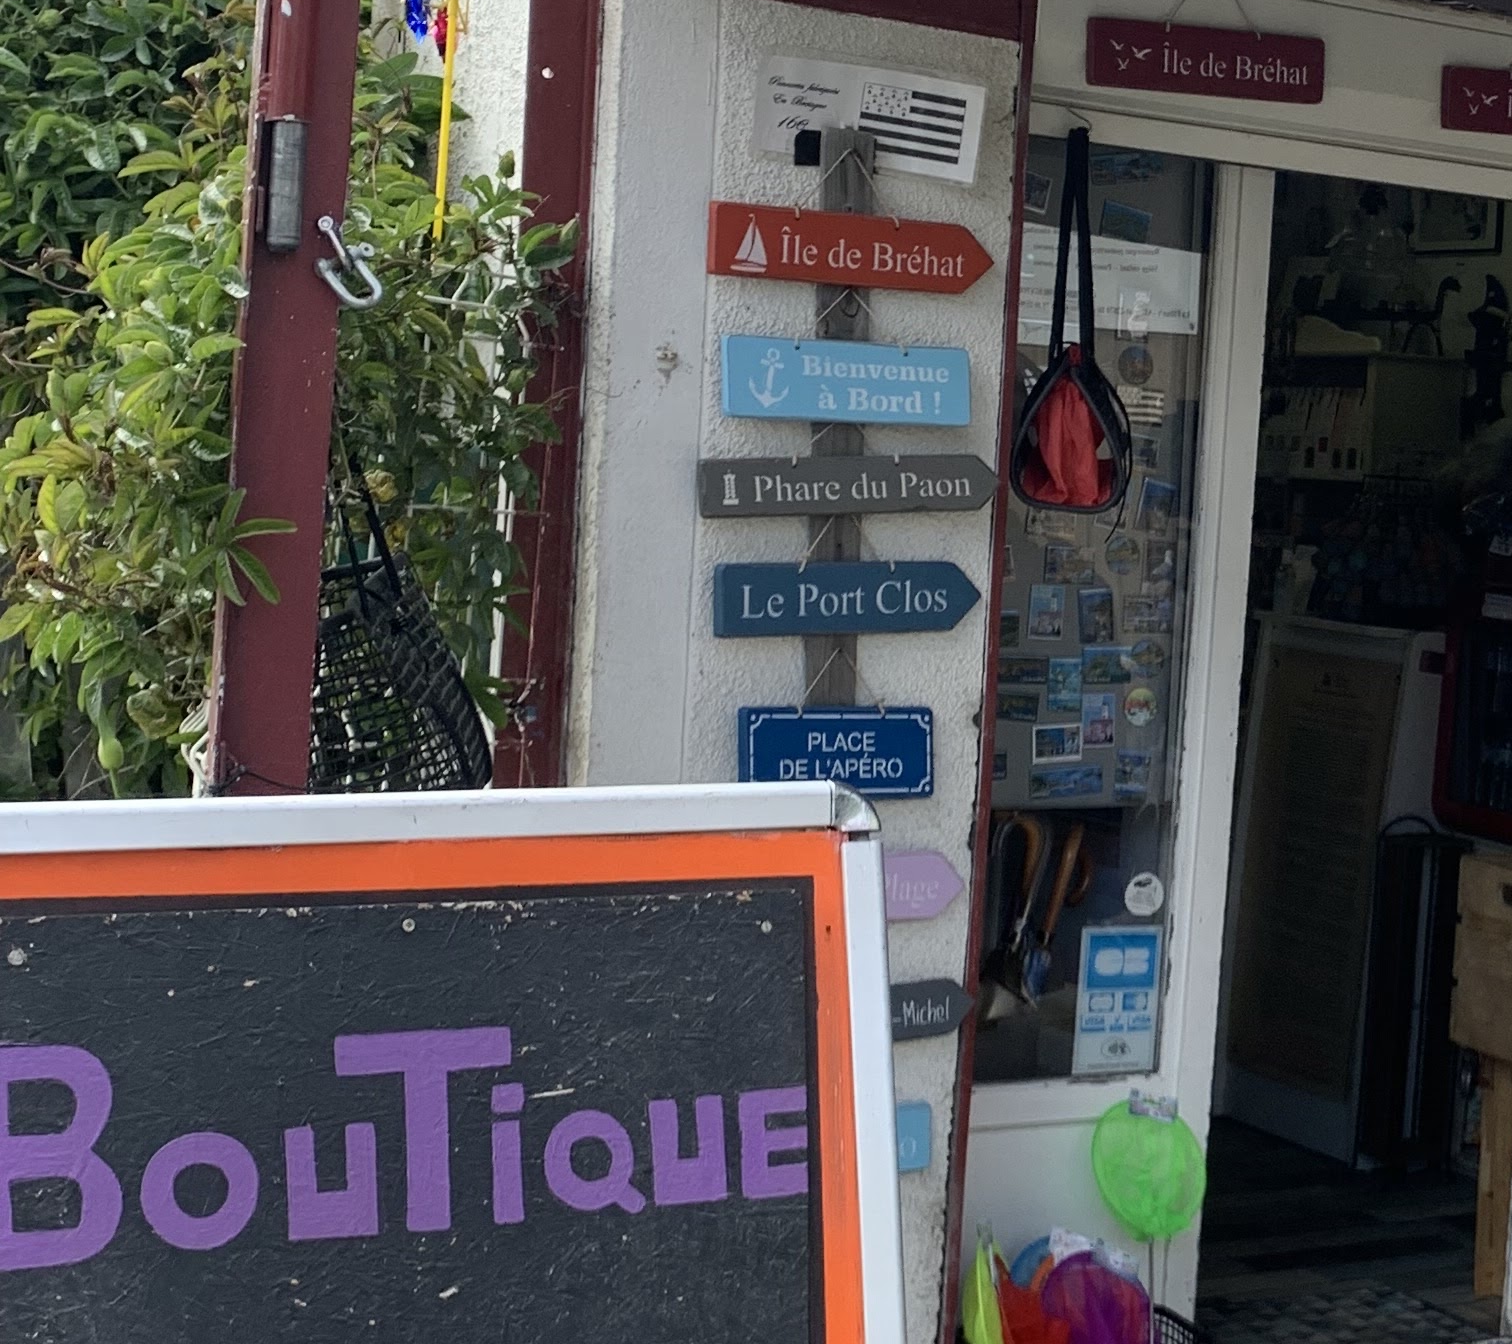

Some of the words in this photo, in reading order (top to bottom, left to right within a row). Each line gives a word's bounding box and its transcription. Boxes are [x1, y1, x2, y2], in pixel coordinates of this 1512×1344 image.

[1162, 41, 1193, 76] Île
[1199, 52, 1227, 79] de
[1235, 56, 1309, 86] Bréhat
[780, 225, 819, 266] Île
[827, 239, 863, 270] de
[872, 242, 966, 279] Bréhat
[802, 353, 950, 385] Bienvenue
[817, 383, 837, 411] à
[847, 387, 923, 415] Bord
[754, 472, 841, 503] Phare
[850, 471, 888, 501] du
[899, 471, 972, 499] Paon
[740, 584, 785, 619] Le
[796, 582, 866, 618] Port
[875, 579, 949, 615] Clos
[807, 730, 877, 753] PLACE
[779, 758, 809, 780] DE
[814, 751, 904, 780] L'APÉRO
[886, 872, 940, 909] lage
